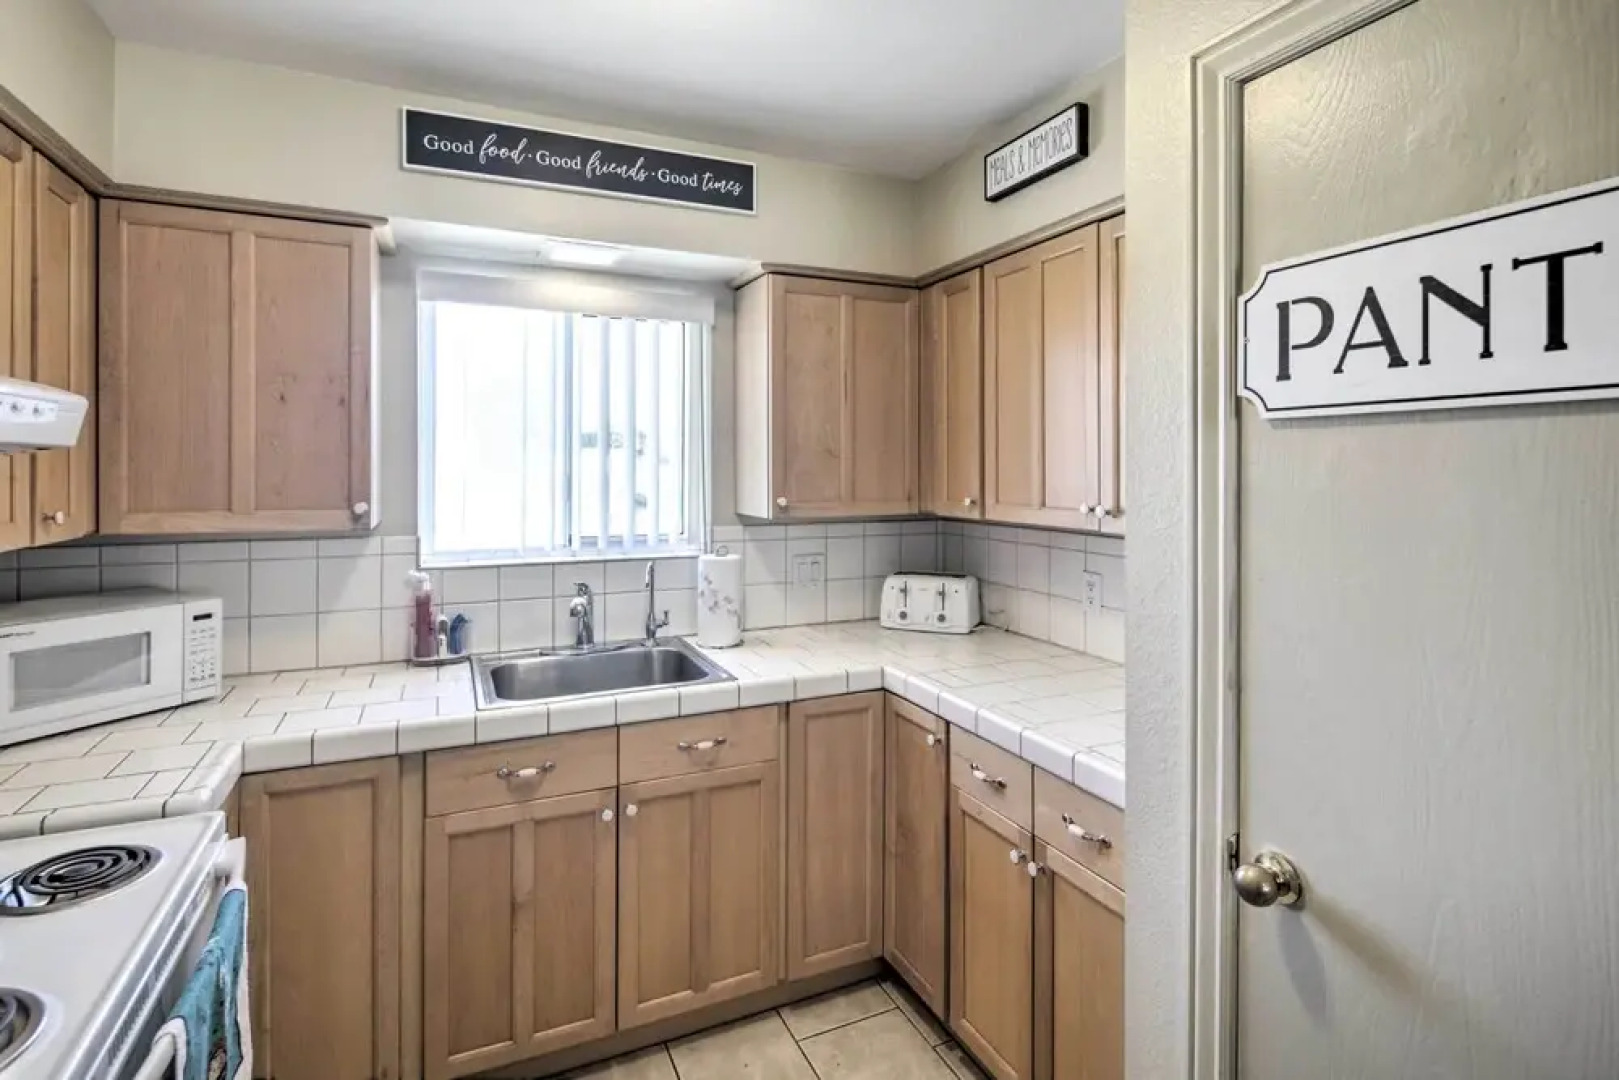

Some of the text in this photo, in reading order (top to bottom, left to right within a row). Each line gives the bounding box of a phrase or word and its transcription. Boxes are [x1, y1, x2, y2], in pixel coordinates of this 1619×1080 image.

[423, 133, 744, 196] Good food Good friends Good times
[990, 117, 1073, 190] MEALS & MEMORIES
[1276, 241, 1604, 382] PANT
